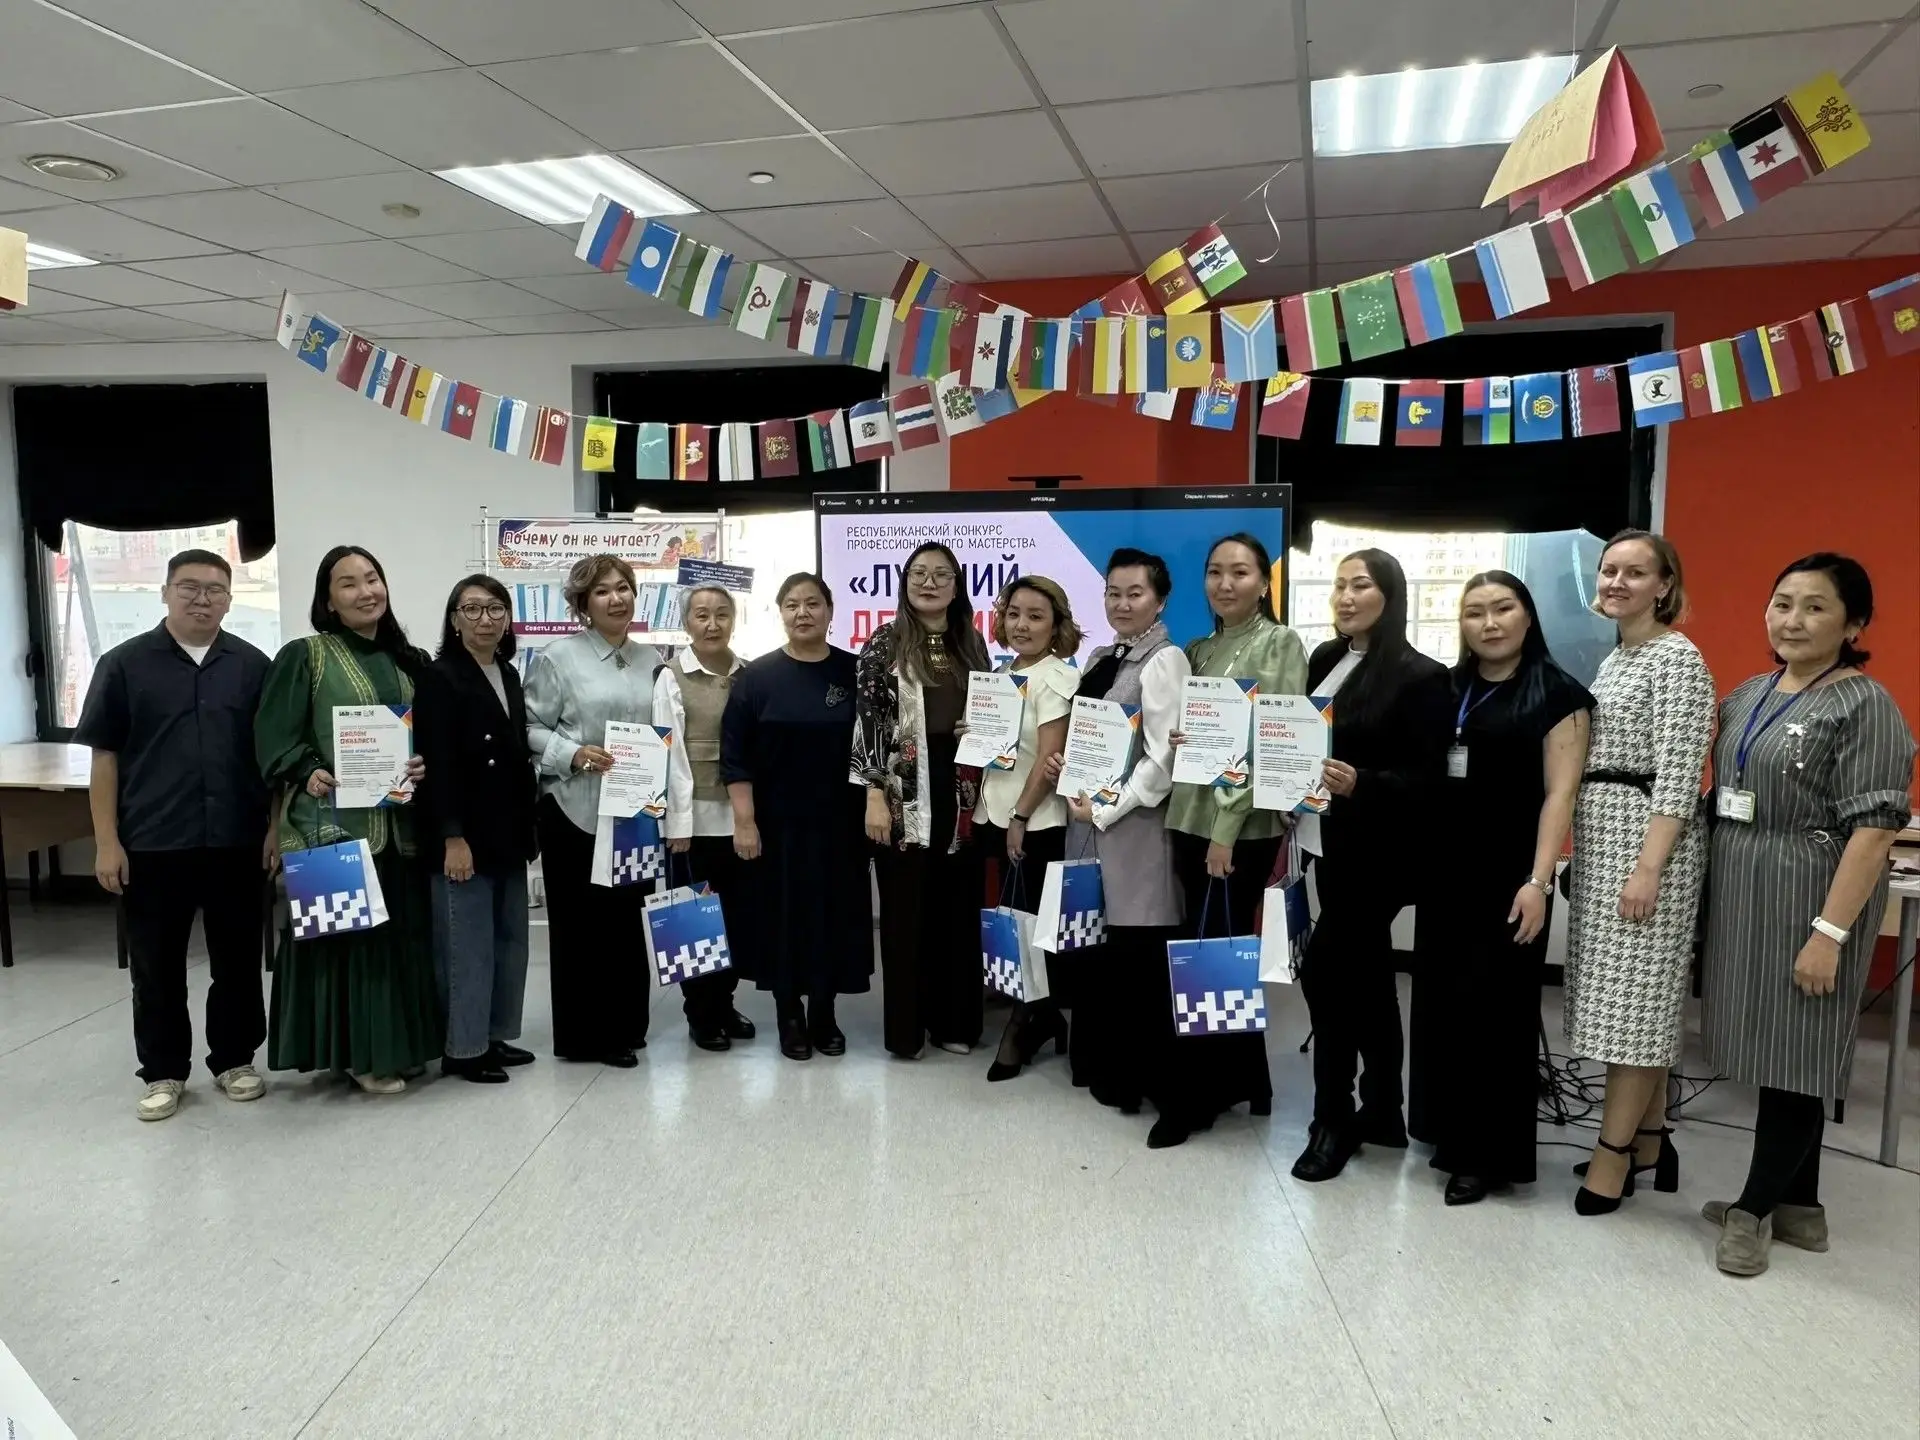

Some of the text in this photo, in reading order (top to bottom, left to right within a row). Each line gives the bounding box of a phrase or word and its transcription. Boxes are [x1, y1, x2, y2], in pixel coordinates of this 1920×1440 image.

[847, 523, 1003, 538] РЕСПУБЛИКАНСКИЙ КОНКУРС
[504, 531, 660, 547] Почему он не читает?
[847, 537, 1036, 550] ПРОФЕССИОНАНОГО МАСТЕРСТВА
